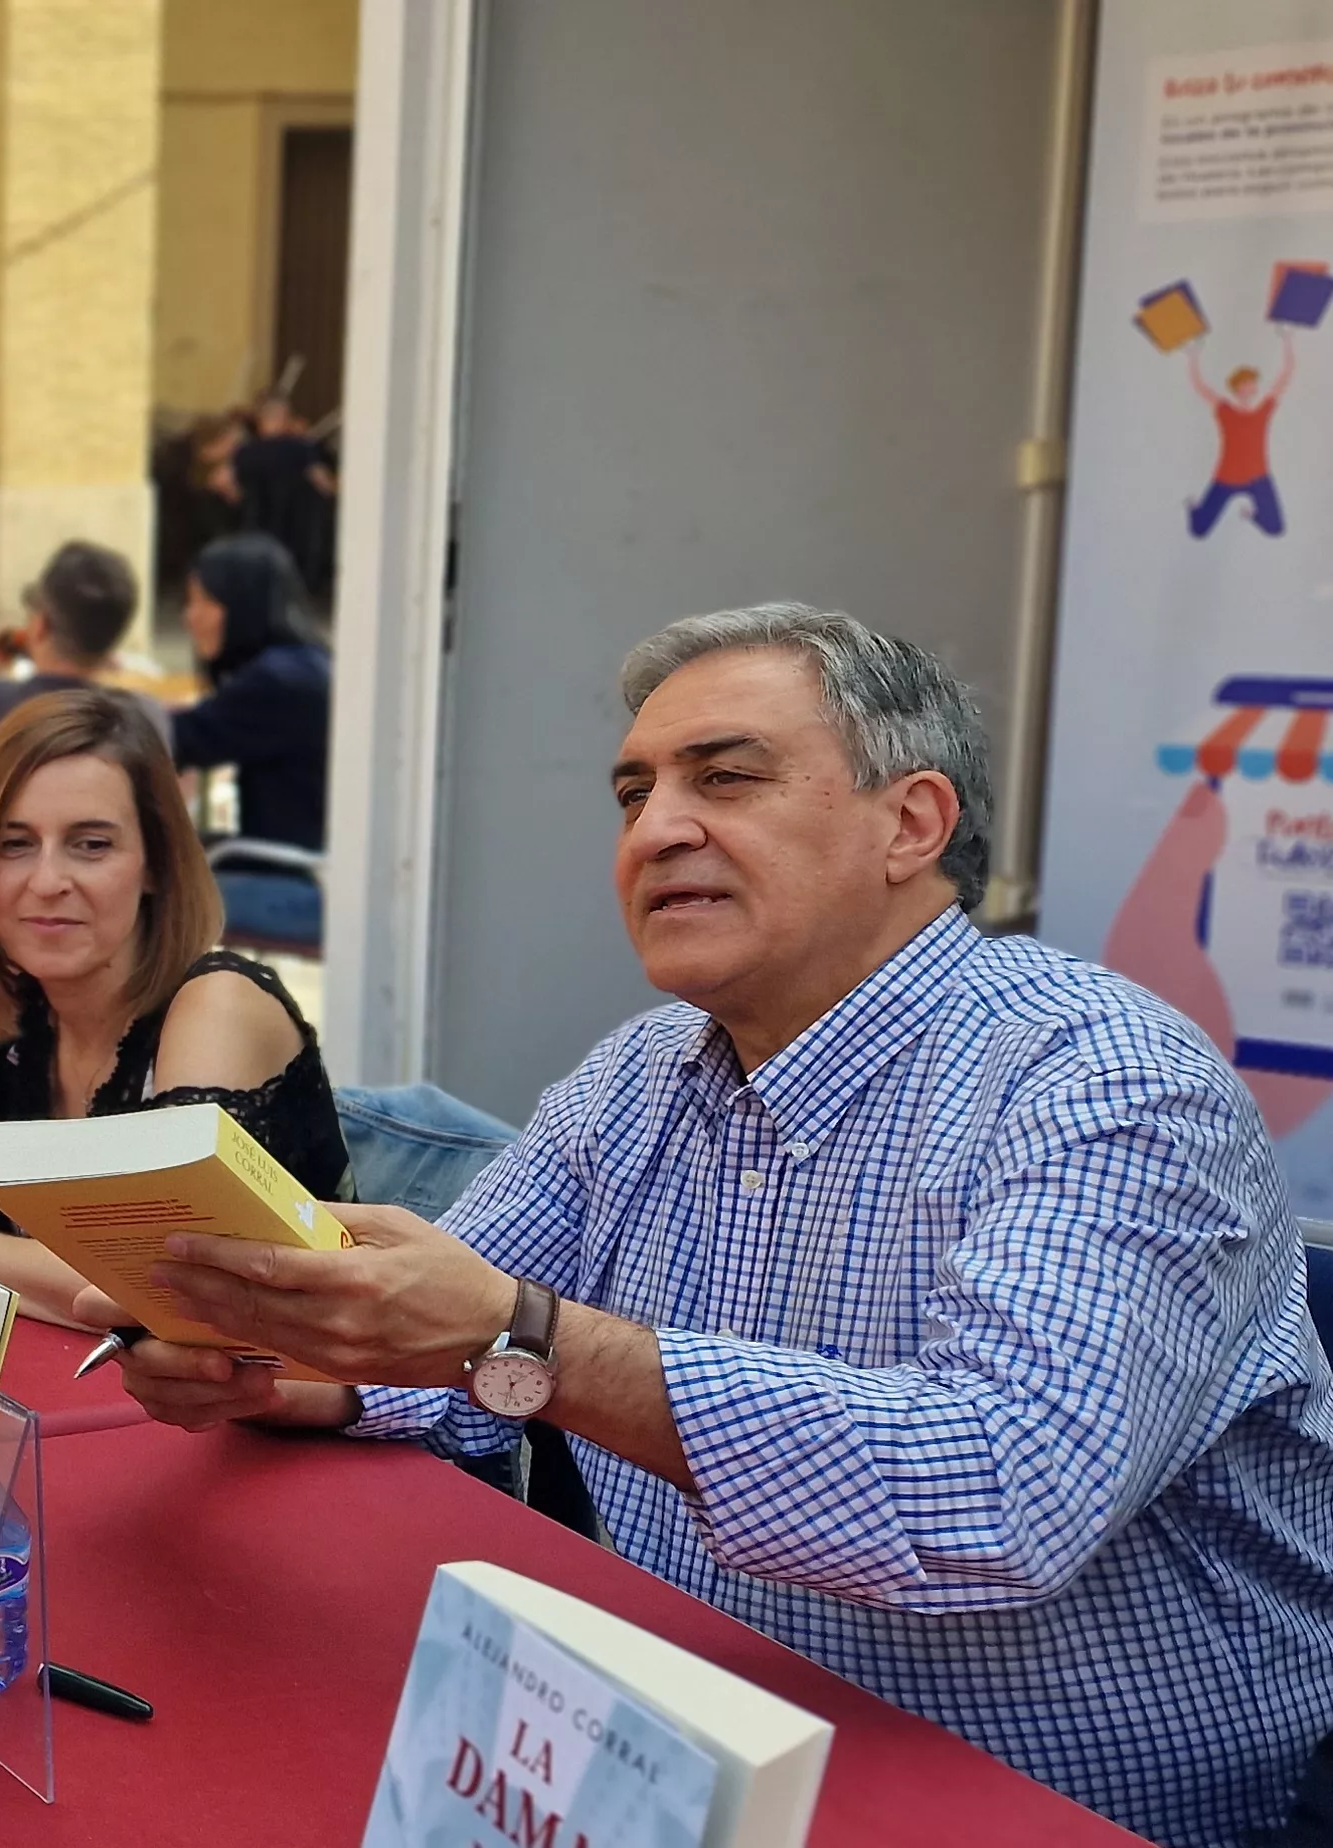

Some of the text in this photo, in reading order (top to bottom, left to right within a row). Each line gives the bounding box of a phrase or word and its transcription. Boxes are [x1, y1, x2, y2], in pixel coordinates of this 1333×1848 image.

[232, 1132, 278, 1183] JOSÉ LUIS
[235, 1151, 274, 1196] CORRAL
[461, 1622, 661, 1785] ALEJANDRO CORRAL
[510, 1717, 553, 1787] LA
[446, 1733, 591, 1848] DAM
